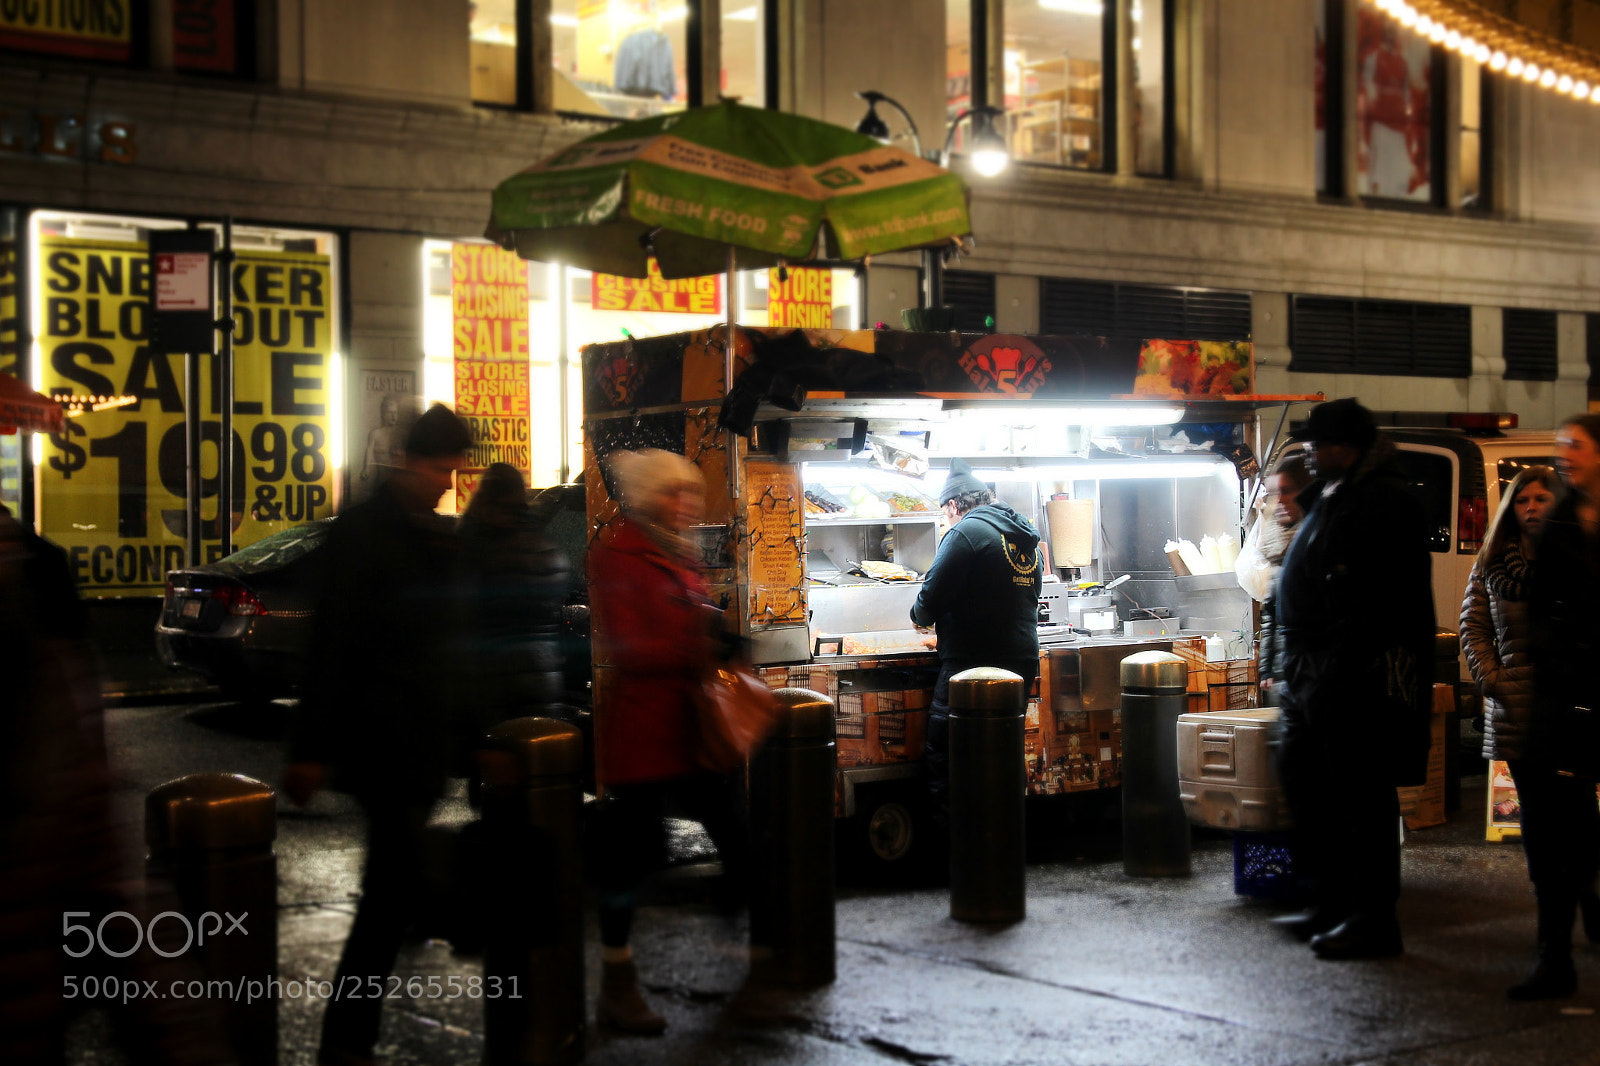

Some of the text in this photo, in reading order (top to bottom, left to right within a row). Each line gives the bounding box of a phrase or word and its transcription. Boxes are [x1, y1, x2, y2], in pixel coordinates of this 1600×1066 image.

[635, 189, 767, 233] FRESH FOOD
[47, 252, 325, 306] SNEKER
[453, 244, 528, 285] STORE
[597, 273, 715, 294] CLOSING
[453, 283, 528, 319] CLOSING
[599, 290, 715, 313] SALE
[769, 266, 831, 303] STORE
[47, 297, 325, 348] BLOOUT
[454, 318, 528, 361] SALE
[49, 342, 326, 417] SALE
[456, 361, 527, 381] STORE
[456, 379, 527, 397] CLOSING
[457, 395, 527, 415] SALE
[70, 545, 185, 587] ECOND
